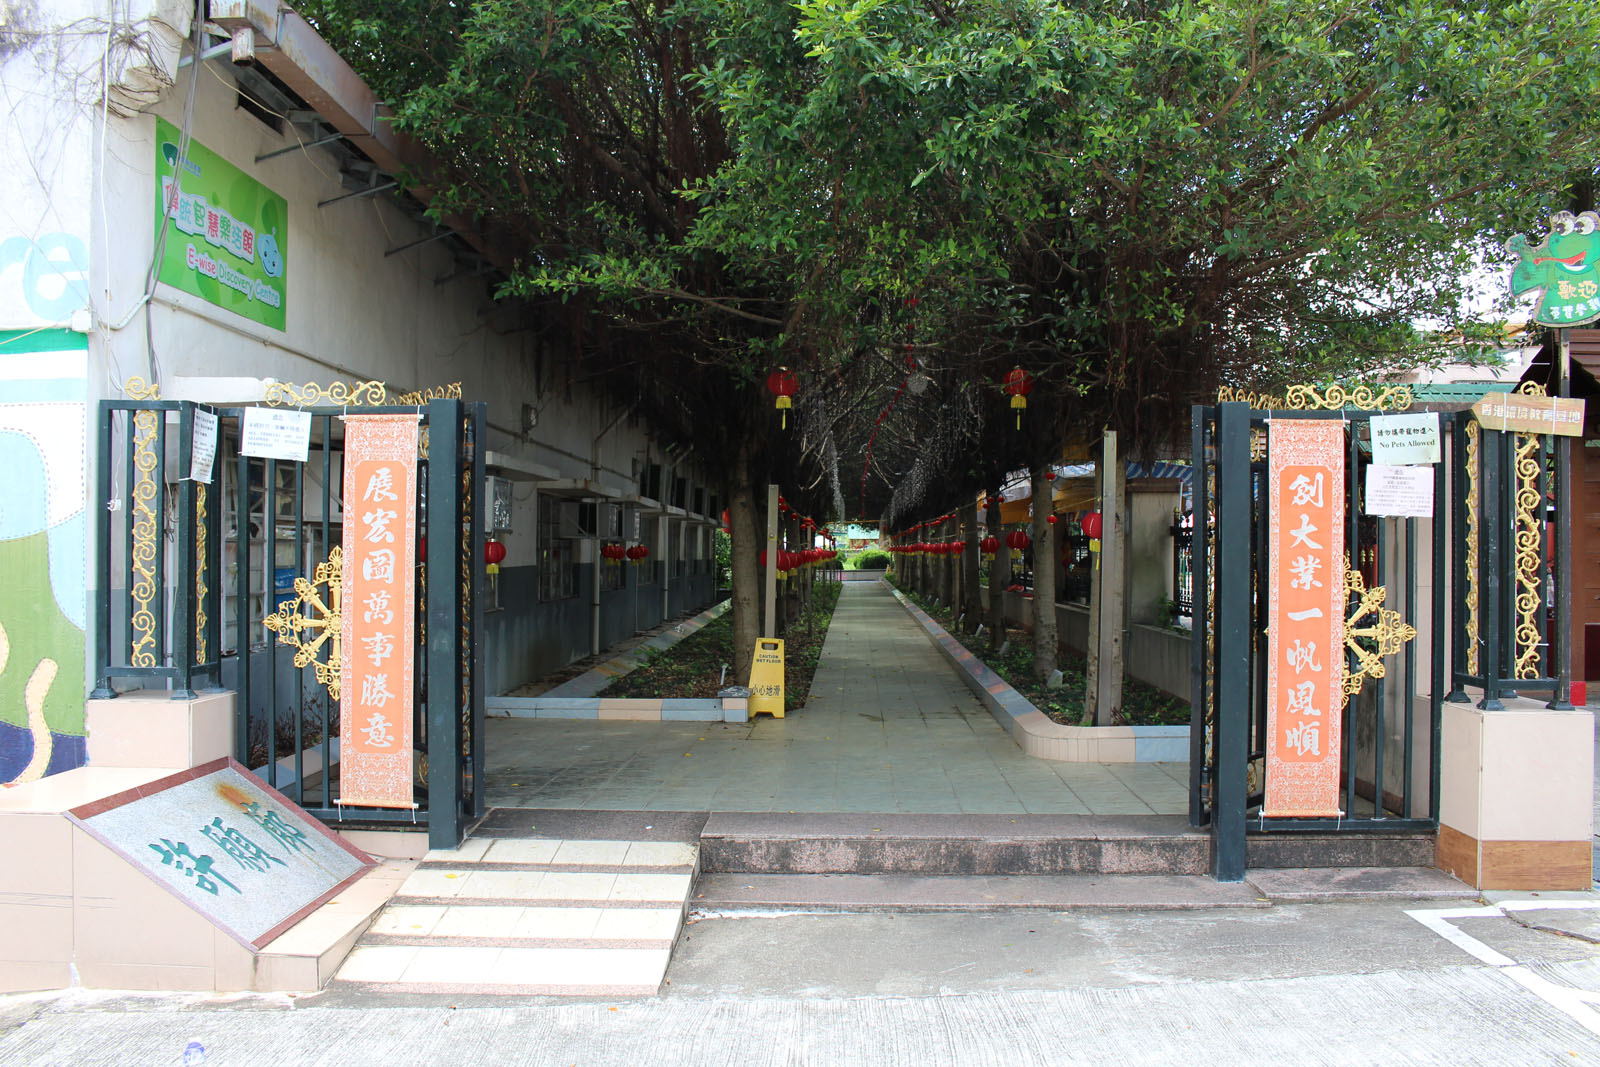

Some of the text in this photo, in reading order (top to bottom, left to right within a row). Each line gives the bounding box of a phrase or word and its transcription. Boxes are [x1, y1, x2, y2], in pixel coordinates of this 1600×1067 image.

[188, 247, 280, 305] E-wise Discovery Centre
[1558, 280, 1598, 299] 歡迎
[1379, 441, 1390, 449] No
[1407, 439, 1435, 447] Allowed
[360, 467, 399, 748] 展宏圖萬事勝意
[1285, 472, 1324, 756] 創大業一帆風順
[752, 684, 780, 696] 小心地滑
[148, 801, 317, 896] 許願廊
